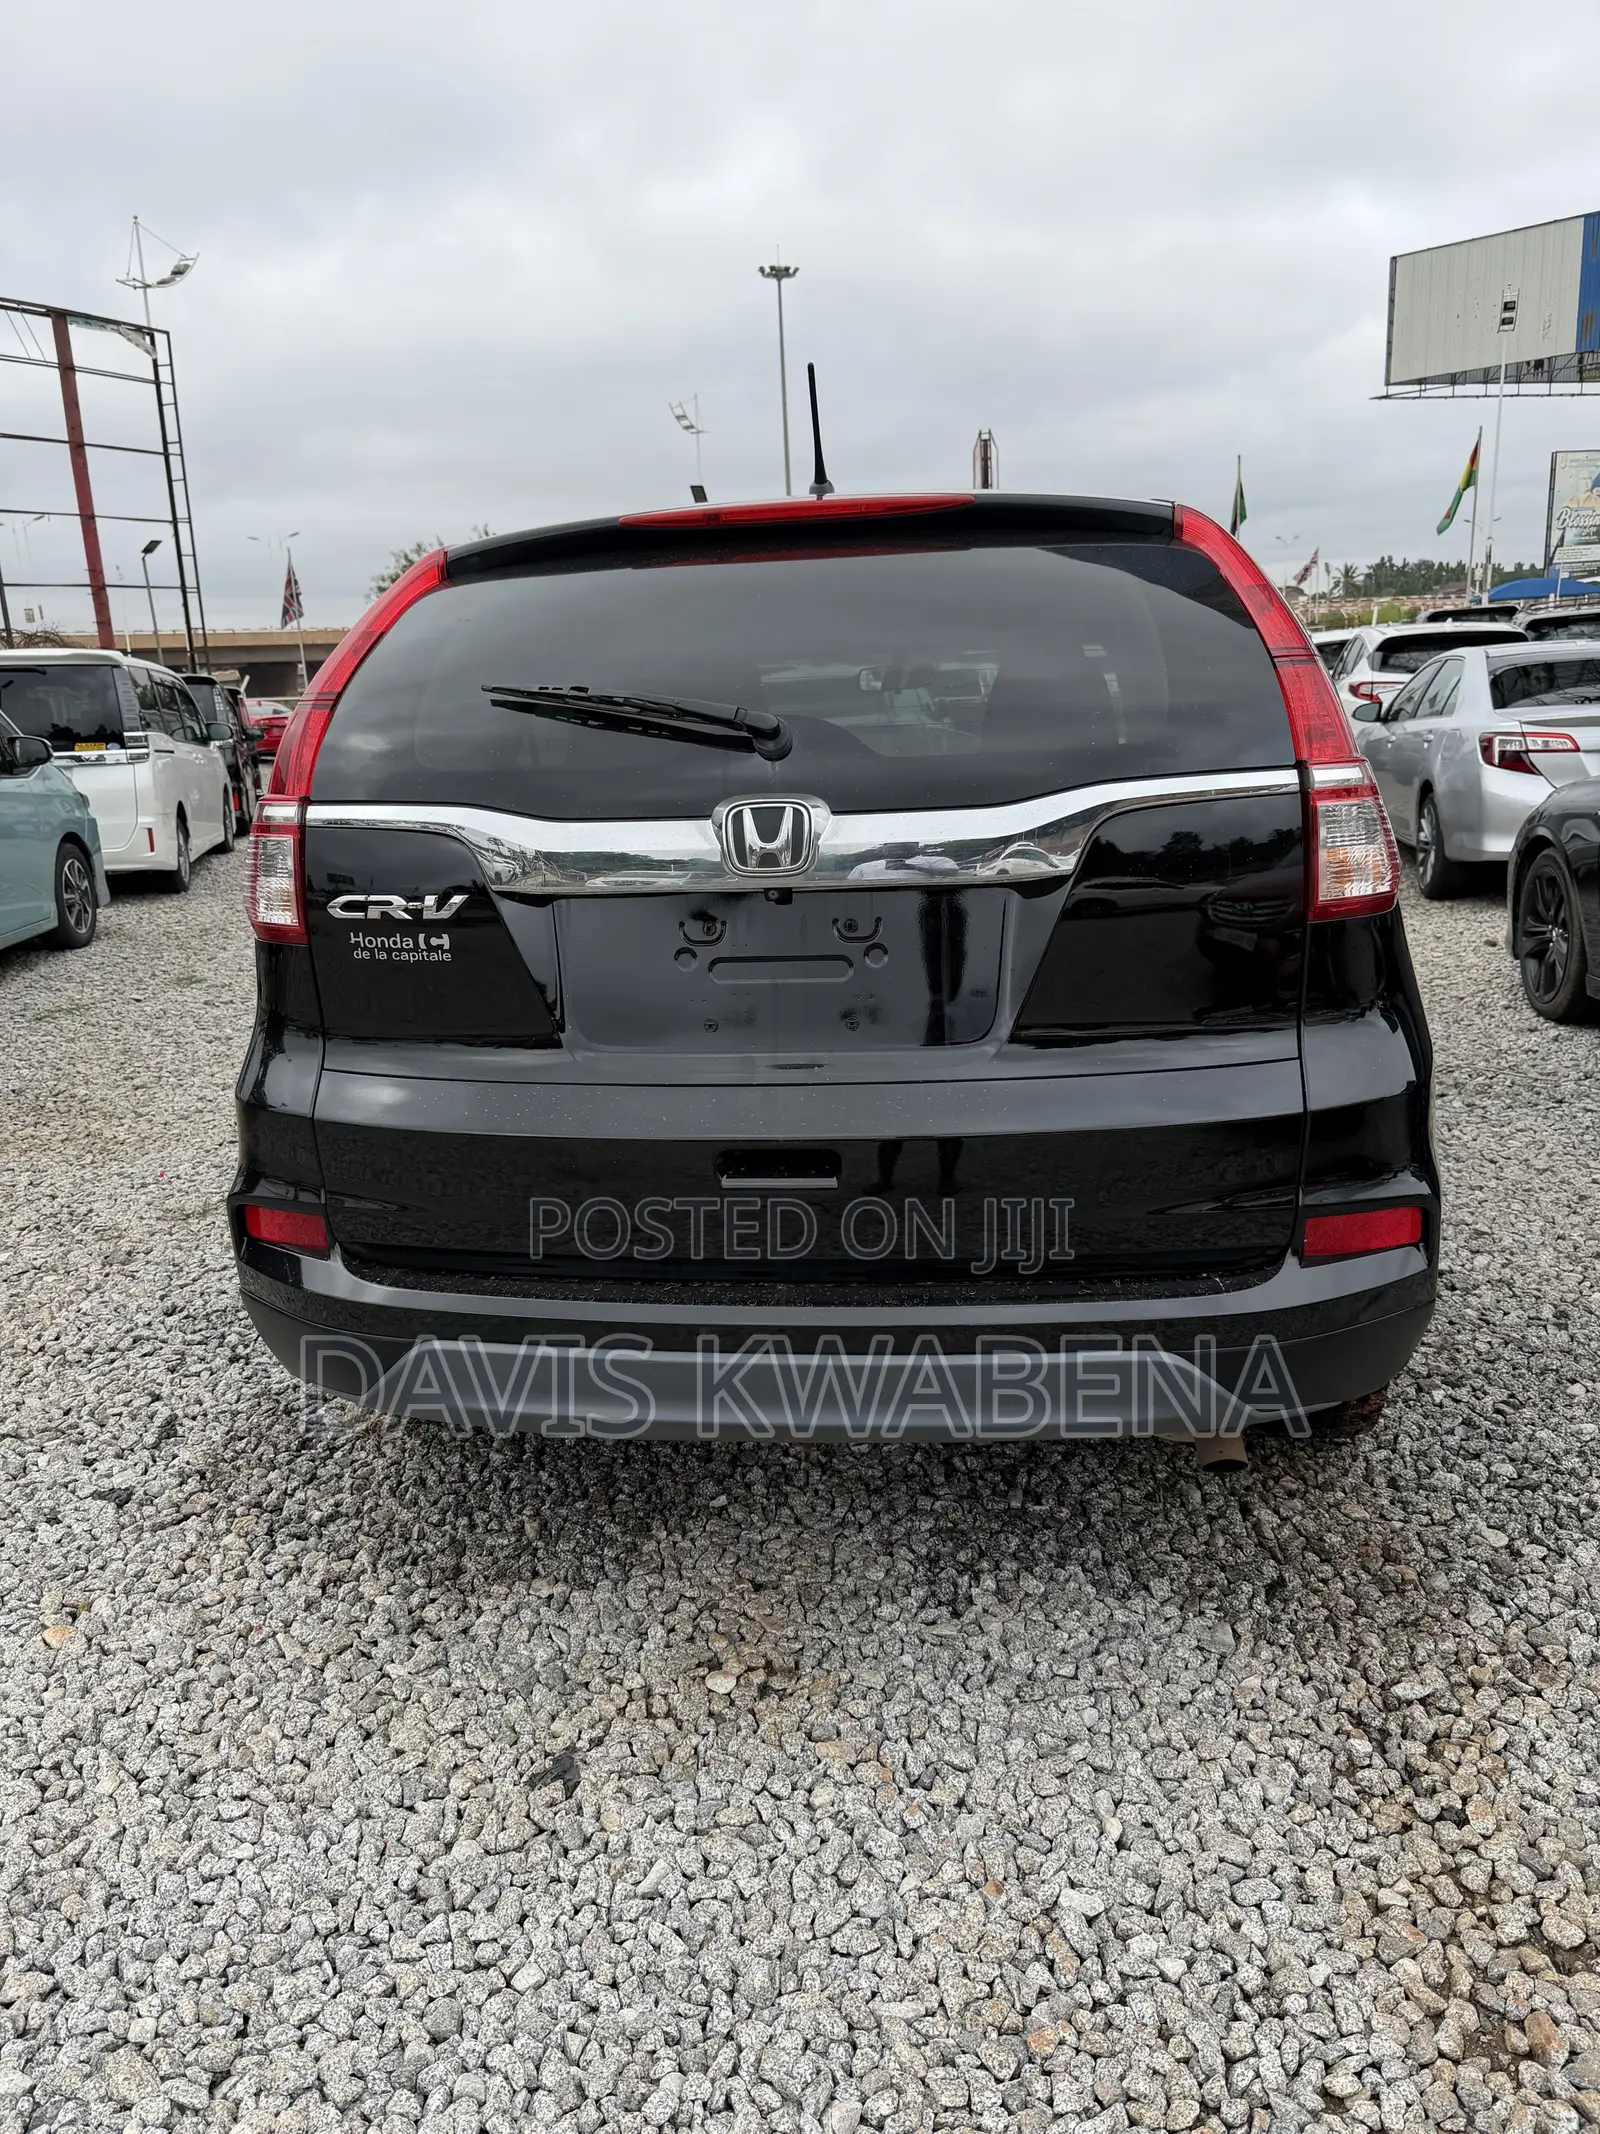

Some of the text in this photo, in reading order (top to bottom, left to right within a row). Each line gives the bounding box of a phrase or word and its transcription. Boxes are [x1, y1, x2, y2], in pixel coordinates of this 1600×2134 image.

[326, 894, 470, 920] CR-V
[350, 932, 414, 949] Honda
[353, 949, 452, 963] de la capitale
